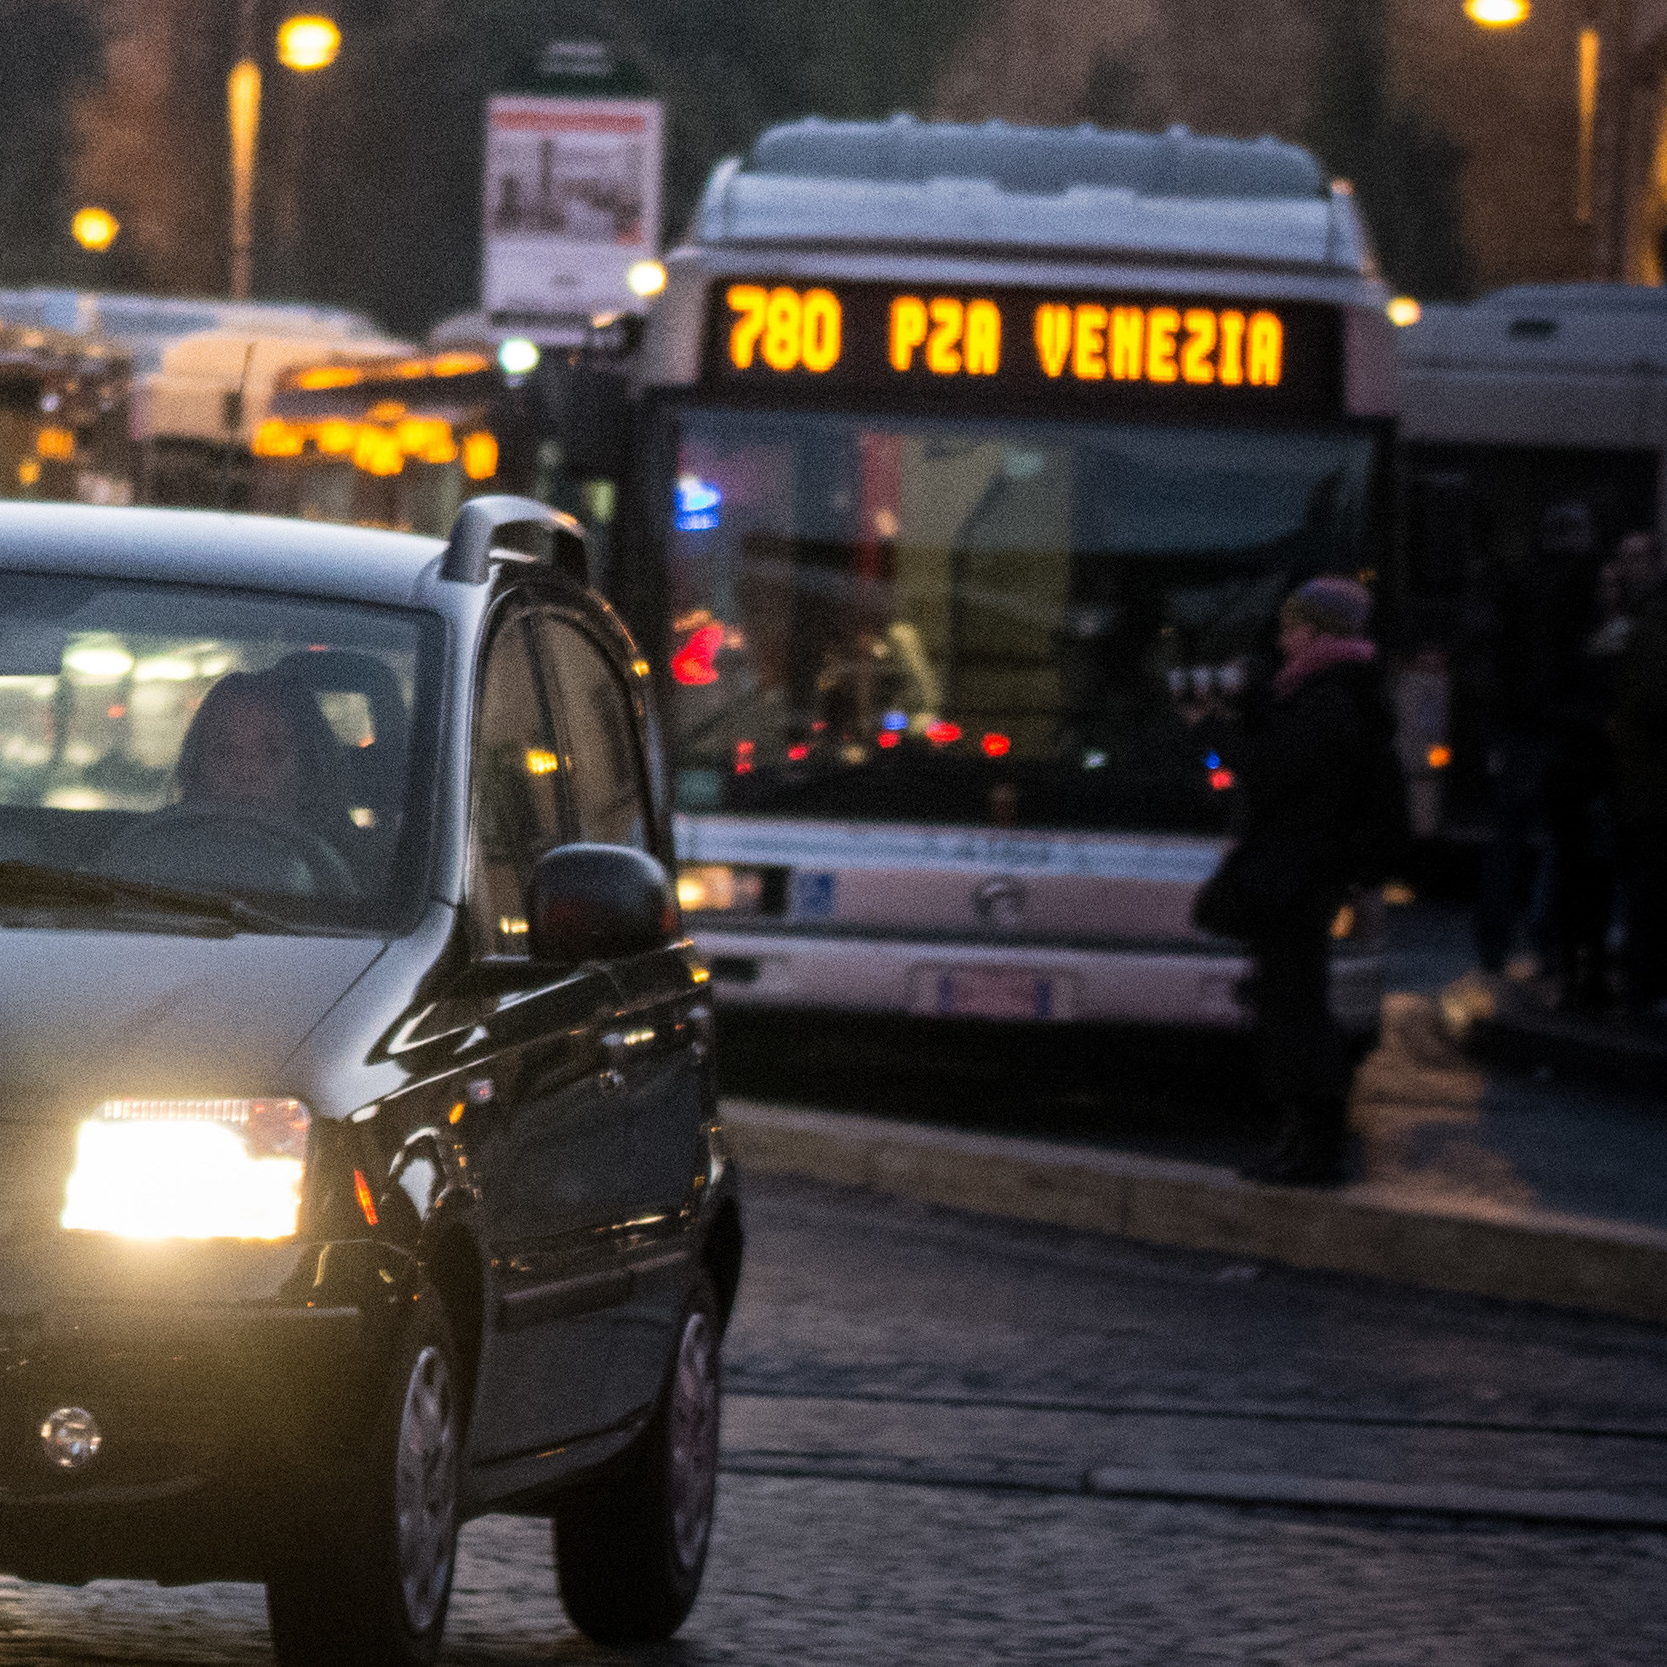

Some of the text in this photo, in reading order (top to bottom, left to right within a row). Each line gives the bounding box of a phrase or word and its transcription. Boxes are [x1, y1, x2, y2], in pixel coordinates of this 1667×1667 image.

[726, 284, 1283, 386] 780 PZA VENEZIA
